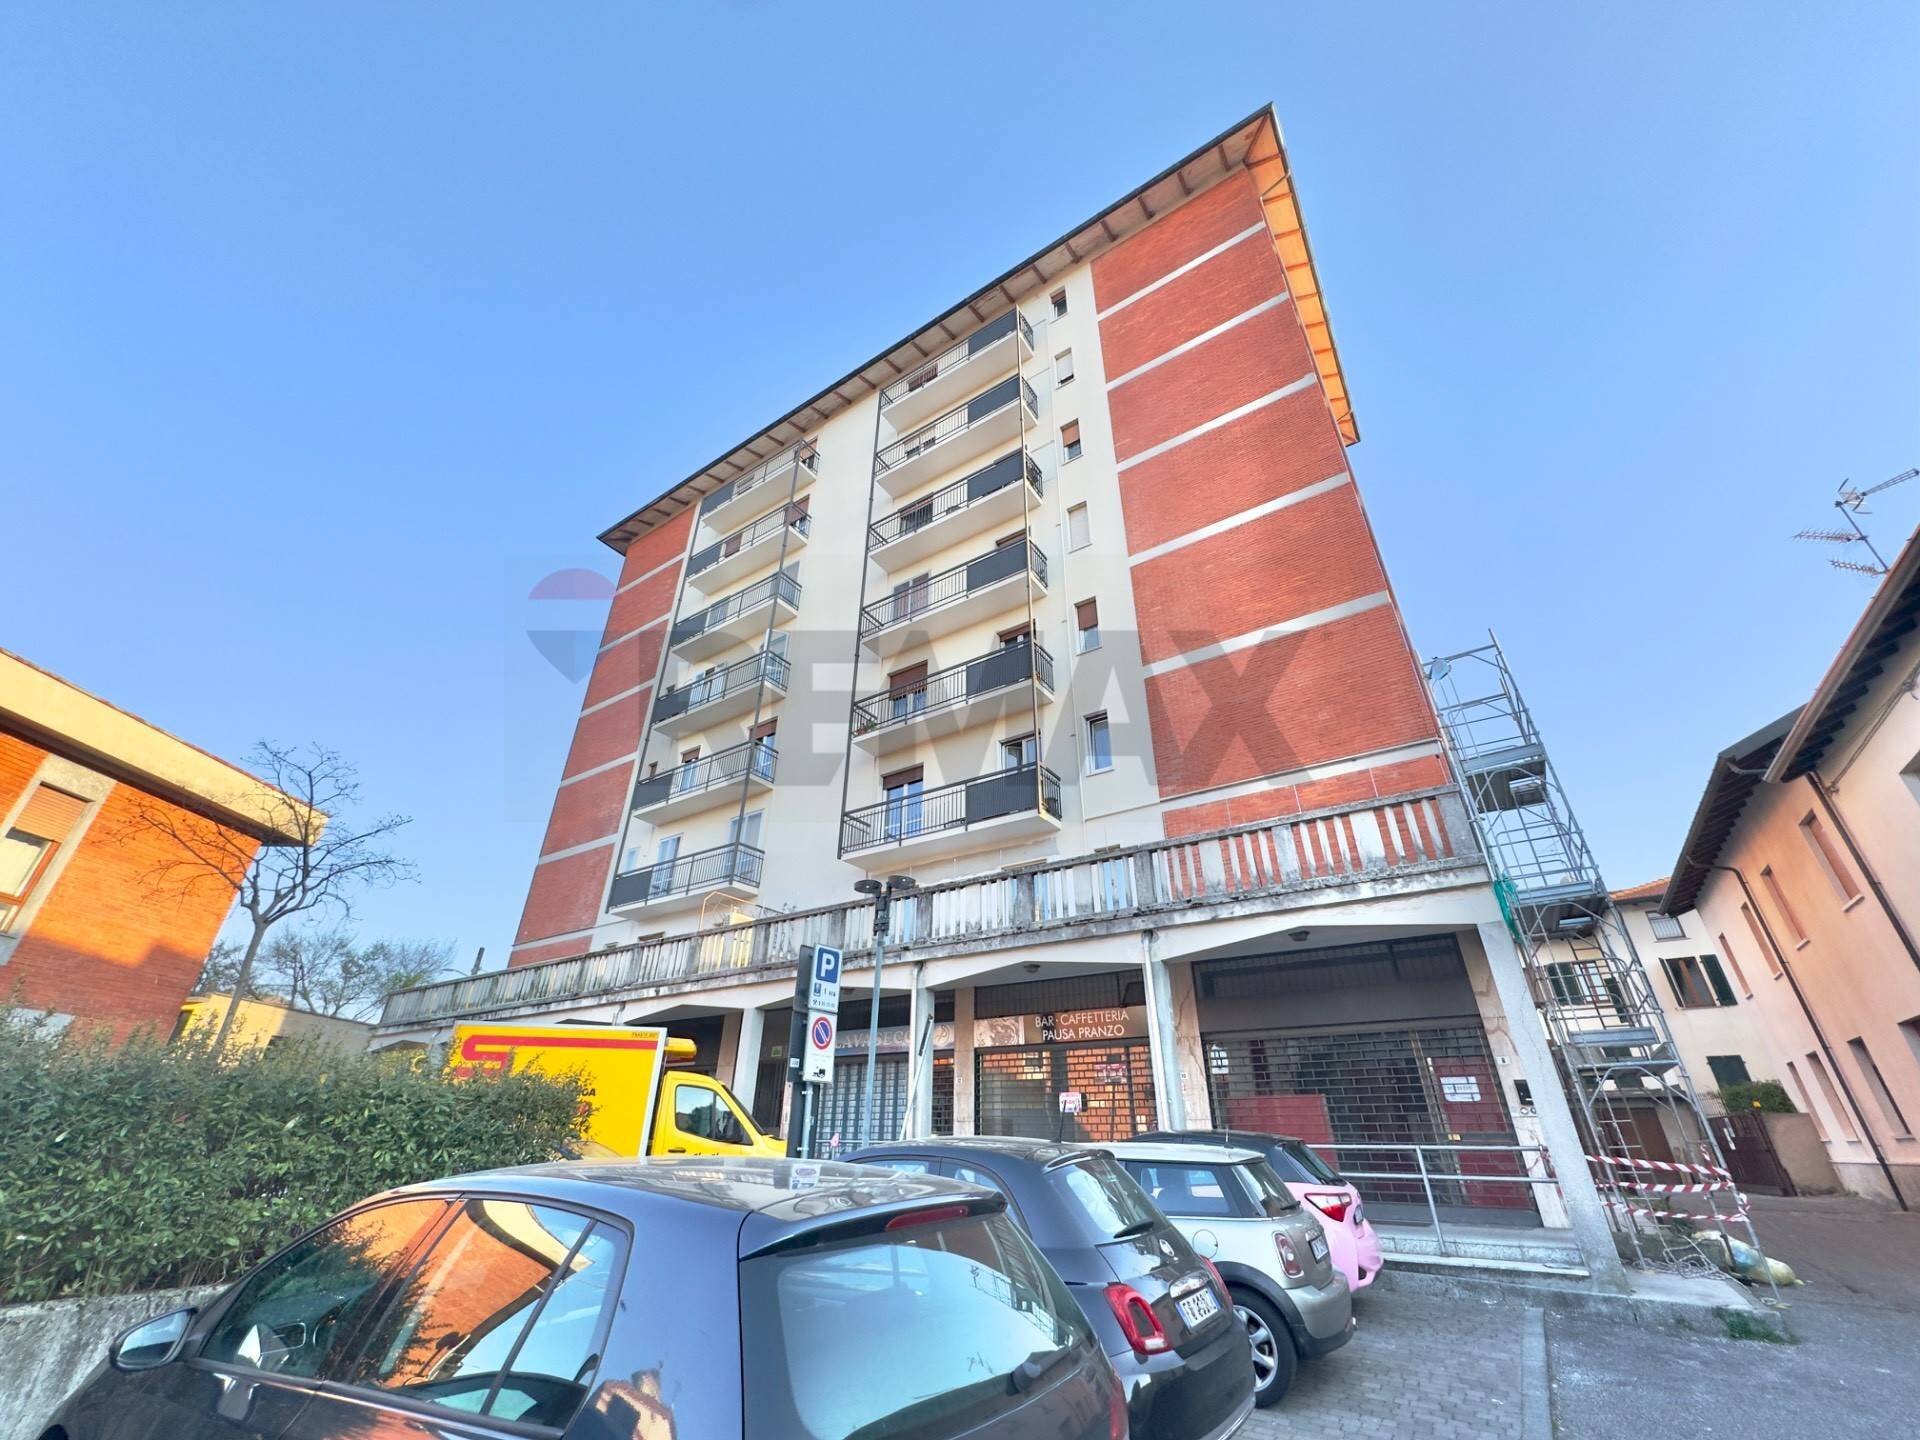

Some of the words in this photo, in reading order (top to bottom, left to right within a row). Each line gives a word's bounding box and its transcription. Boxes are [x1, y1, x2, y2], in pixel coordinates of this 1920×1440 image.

[820, 953, 836, 977] P
[1035, 1015, 1055, 1028] BAR
[1060, 1009, 1130, 1026] CAFFETTERIA
[1042, 1028, 1076, 1041] PAUSA
[1078, 1024, 1125, 1039] PRANZO
